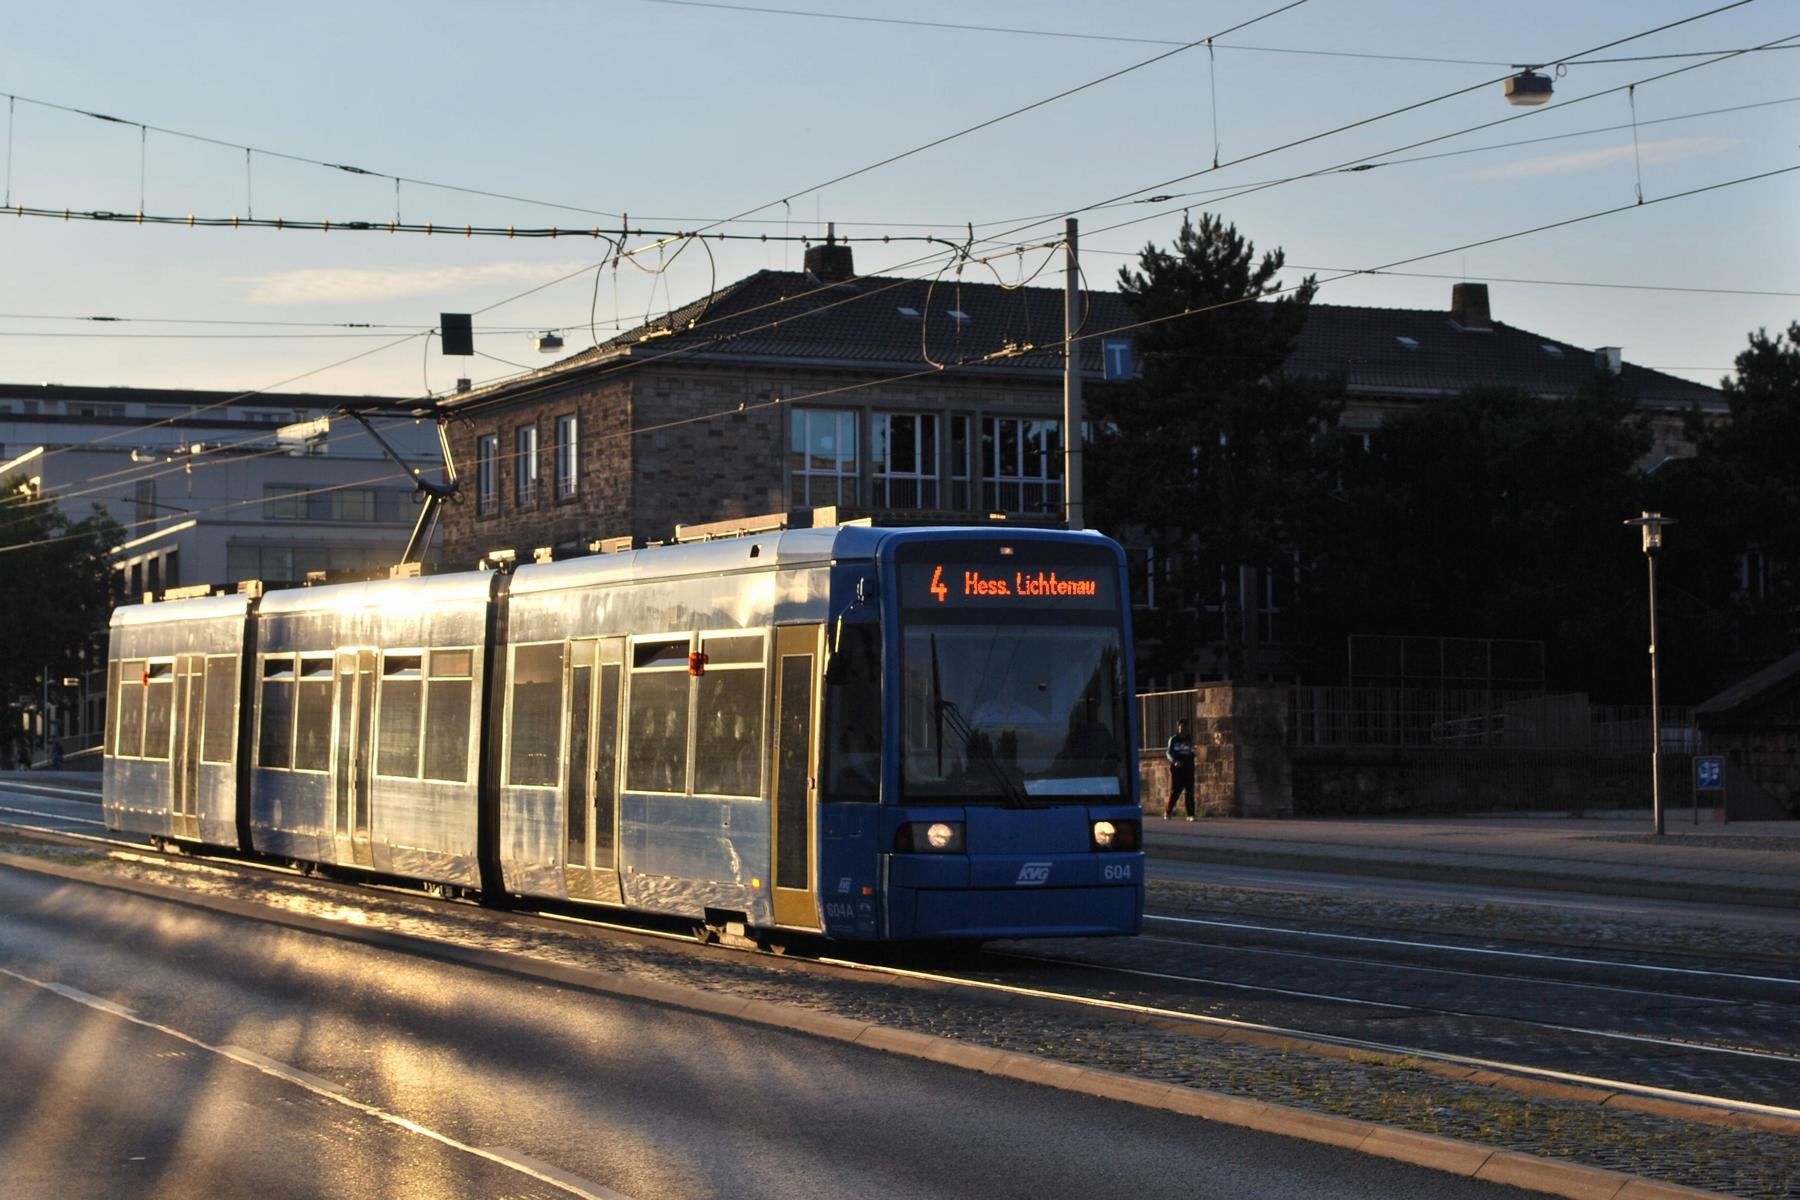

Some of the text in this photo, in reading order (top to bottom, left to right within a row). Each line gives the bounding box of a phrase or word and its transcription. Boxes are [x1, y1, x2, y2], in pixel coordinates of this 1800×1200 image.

[1107, 344, 1128, 375] T
[930, 565, 1096, 602] 4 Hess. Lichtenau
[1016, 864, 1051, 882] KVG
[1104, 864, 1131, 880] 604
[826, 902, 855, 919] 604A
